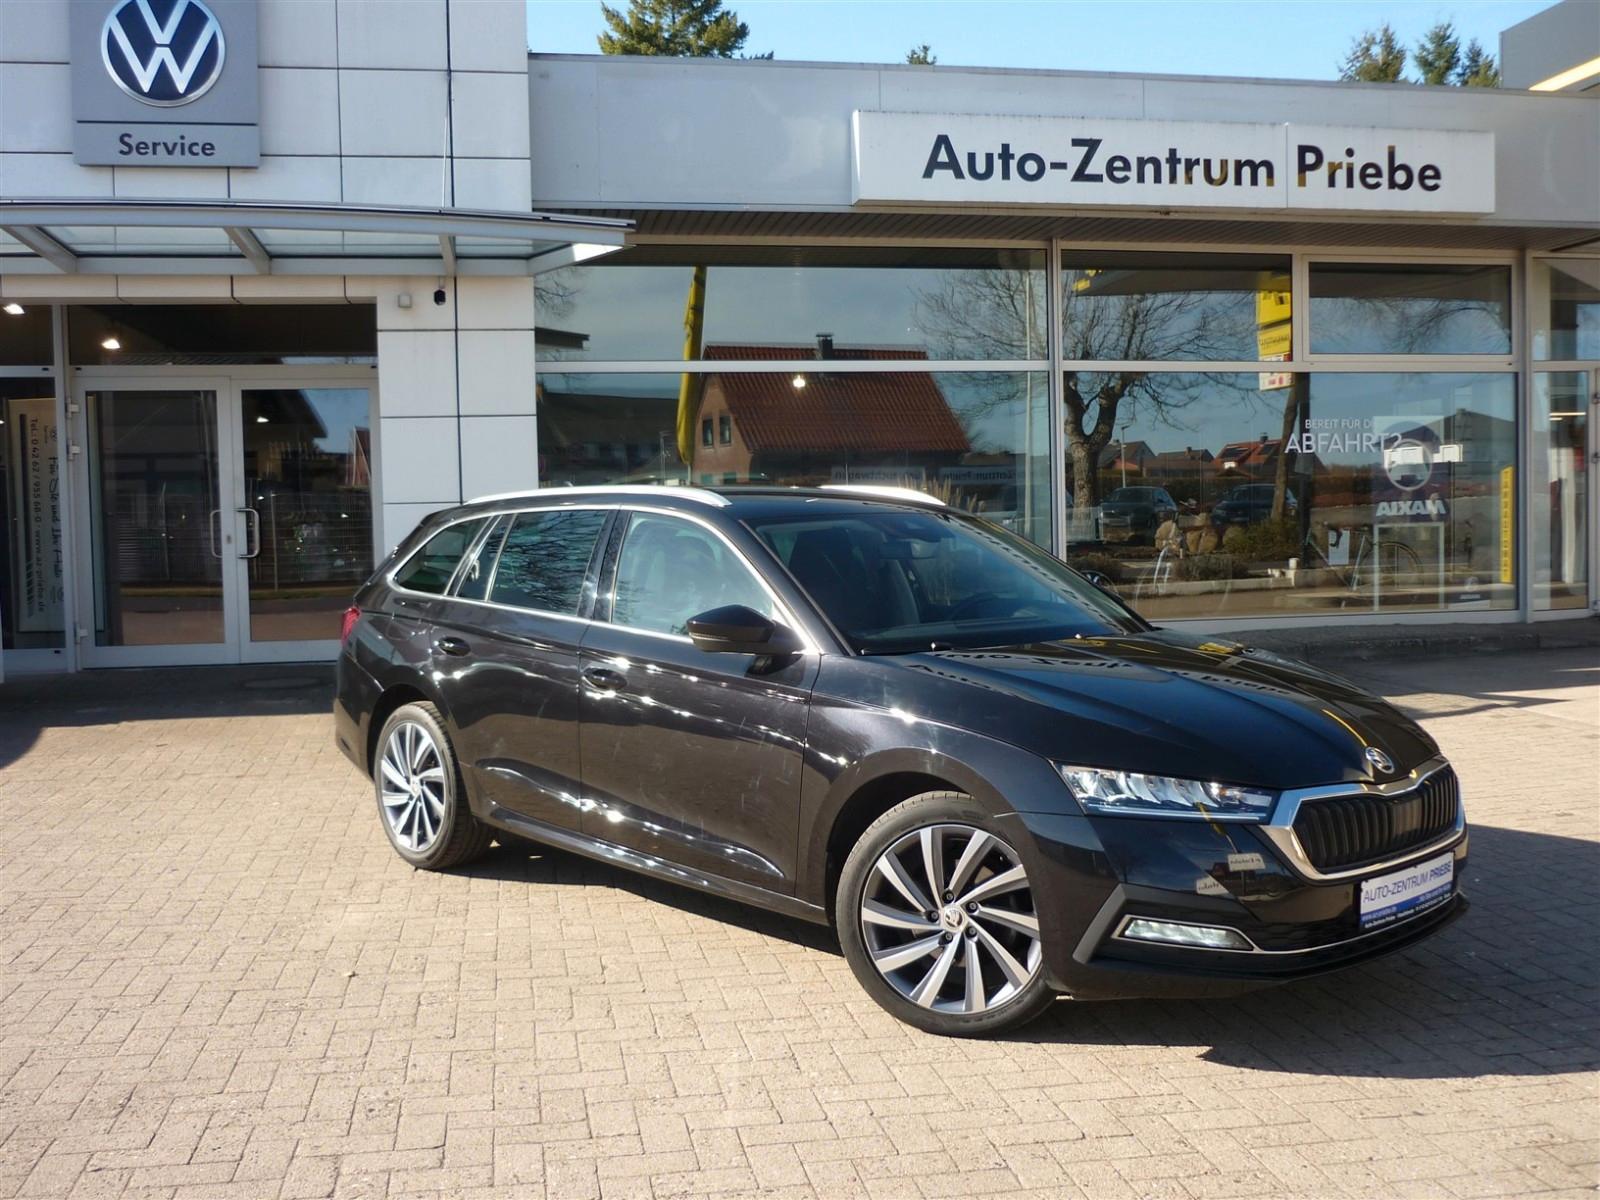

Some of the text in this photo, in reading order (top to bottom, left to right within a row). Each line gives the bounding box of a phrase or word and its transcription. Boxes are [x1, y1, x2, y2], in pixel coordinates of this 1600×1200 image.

[118, 132, 216, 157] Service
[922, 134, 1442, 193] Auto-Zentrum Priebe
[1304, 418, 1338, 429] BEREIT
[1376, 499, 1447, 517] AIXAM
[1363, 871, 1429, 903] AUTO-ZENTRUM
[1429, 860, 1452, 881] PRIEBE
